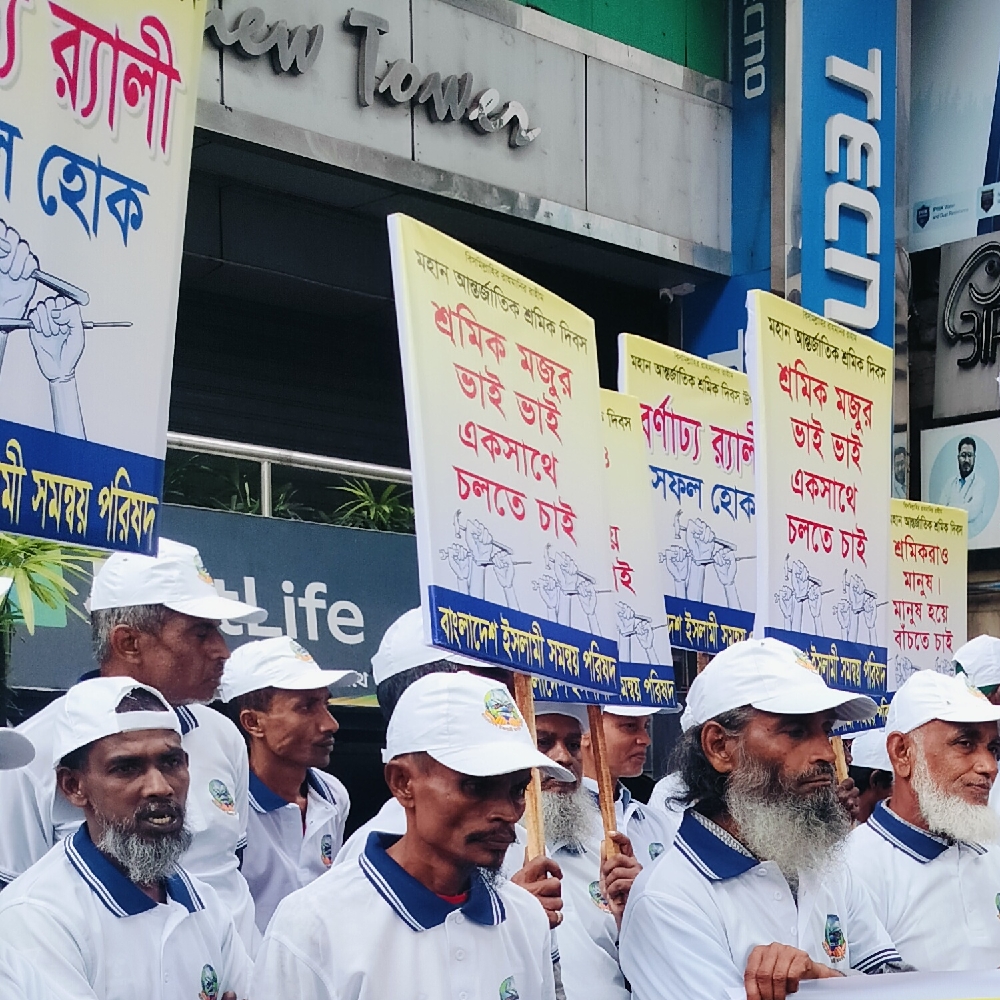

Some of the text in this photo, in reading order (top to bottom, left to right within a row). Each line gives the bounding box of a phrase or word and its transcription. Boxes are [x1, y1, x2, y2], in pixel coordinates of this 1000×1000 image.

[48, 1, 182, 154] র‍্যালী
[345, 7, 543, 149] Tower
[37, 144, 150, 247] হোক
[414, 249, 588, 355] মহান আন্তর্জাতিক শ্রমিক দিবস
[431, 300, 573, 404] শ্রমিক মজুর
[630, 353, 652, 376] মহান
[767, 316, 791, 344] মহান
[793, 332, 840, 362] আন্তর্জাতিক
[841, 346, 865, 375] শ্রমিক
[866, 354, 887, 384] দিবস
[453, 361, 563, 446] ভাই ভাই
[607, 408, 632, 432] দিবস
[639, 394, 703, 462] বর্ণাঢ্য
[777, 358, 829, 411] শ্রমিক
[834, 386, 874, 435] মজুর
[459, 420, 559, 489] একসাথে
[789, 413, 864, 475] ভাই ভাই
[32, 470, 93, 539] সমন্বয়
[98, 467, 160, 551] পরিষদ
[452, 465, 578, 547] চলতে চাই
[648, 464, 756, 523] সফল হোক
[791, 468, 859, 516] একসাথে
[785, 513, 868, 568] চলতে চাই
[893, 534, 949, 565] শ্রমিকরাও
[684, 608, 719, 650] ইসলামী
[892, 600, 949, 625] মানুষ হয়ে
[893, 623, 954, 654] বাঁচতে চাই
[438, 606, 498, 656] বাংলাদেশ
[500, 611, 544, 669] ইসলামী
[547, 637, 580, 678] সমন্বয়
[583, 640, 616, 690] পরিষদ
[864, 650, 887, 692] পরিষদ
[643, 669, 675, 705] পরিষদ
